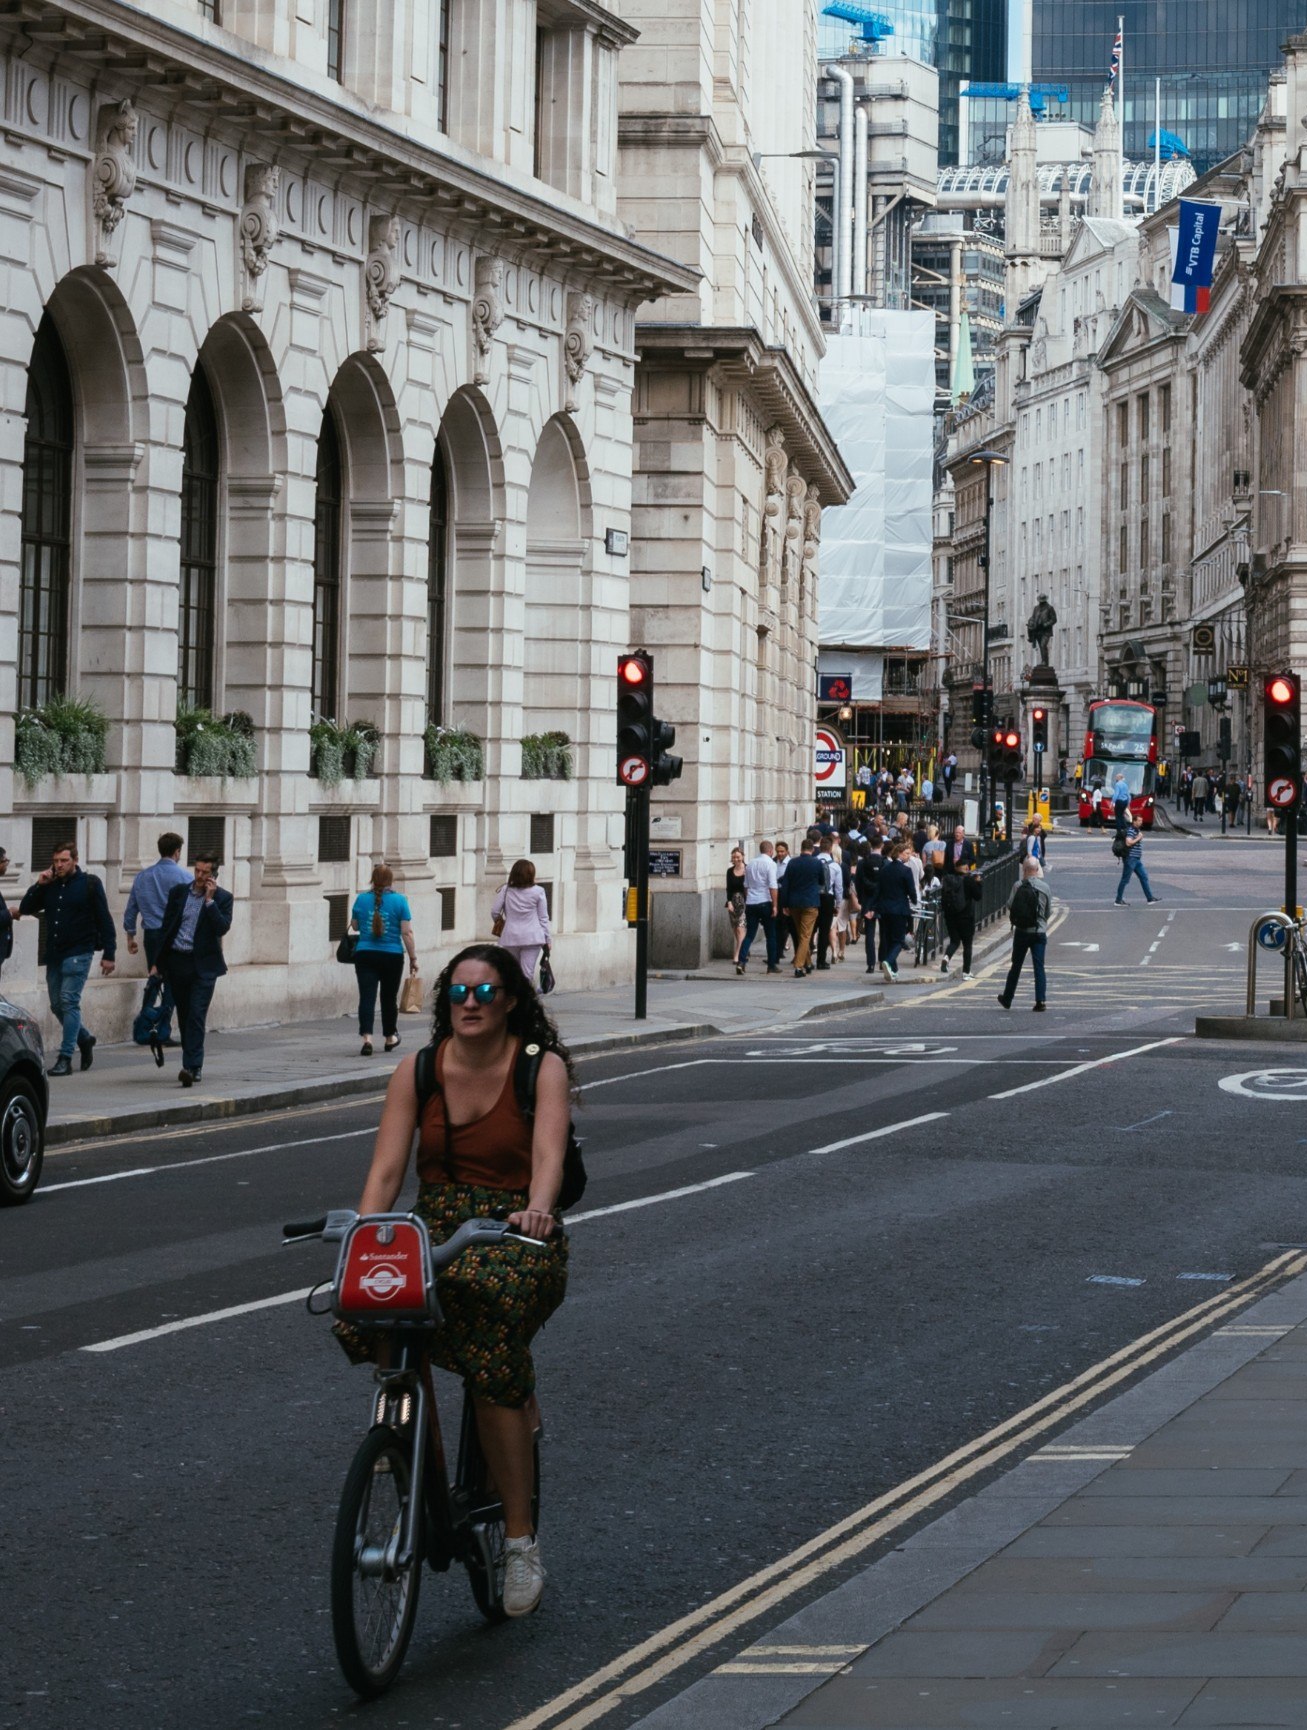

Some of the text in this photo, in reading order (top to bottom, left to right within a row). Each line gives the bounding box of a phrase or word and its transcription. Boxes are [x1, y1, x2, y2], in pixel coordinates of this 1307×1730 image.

[1188, 212, 1205, 267] VTB Capital
[1134, 743, 1145, 752] 25
[817, 790, 842, 798] STATION
